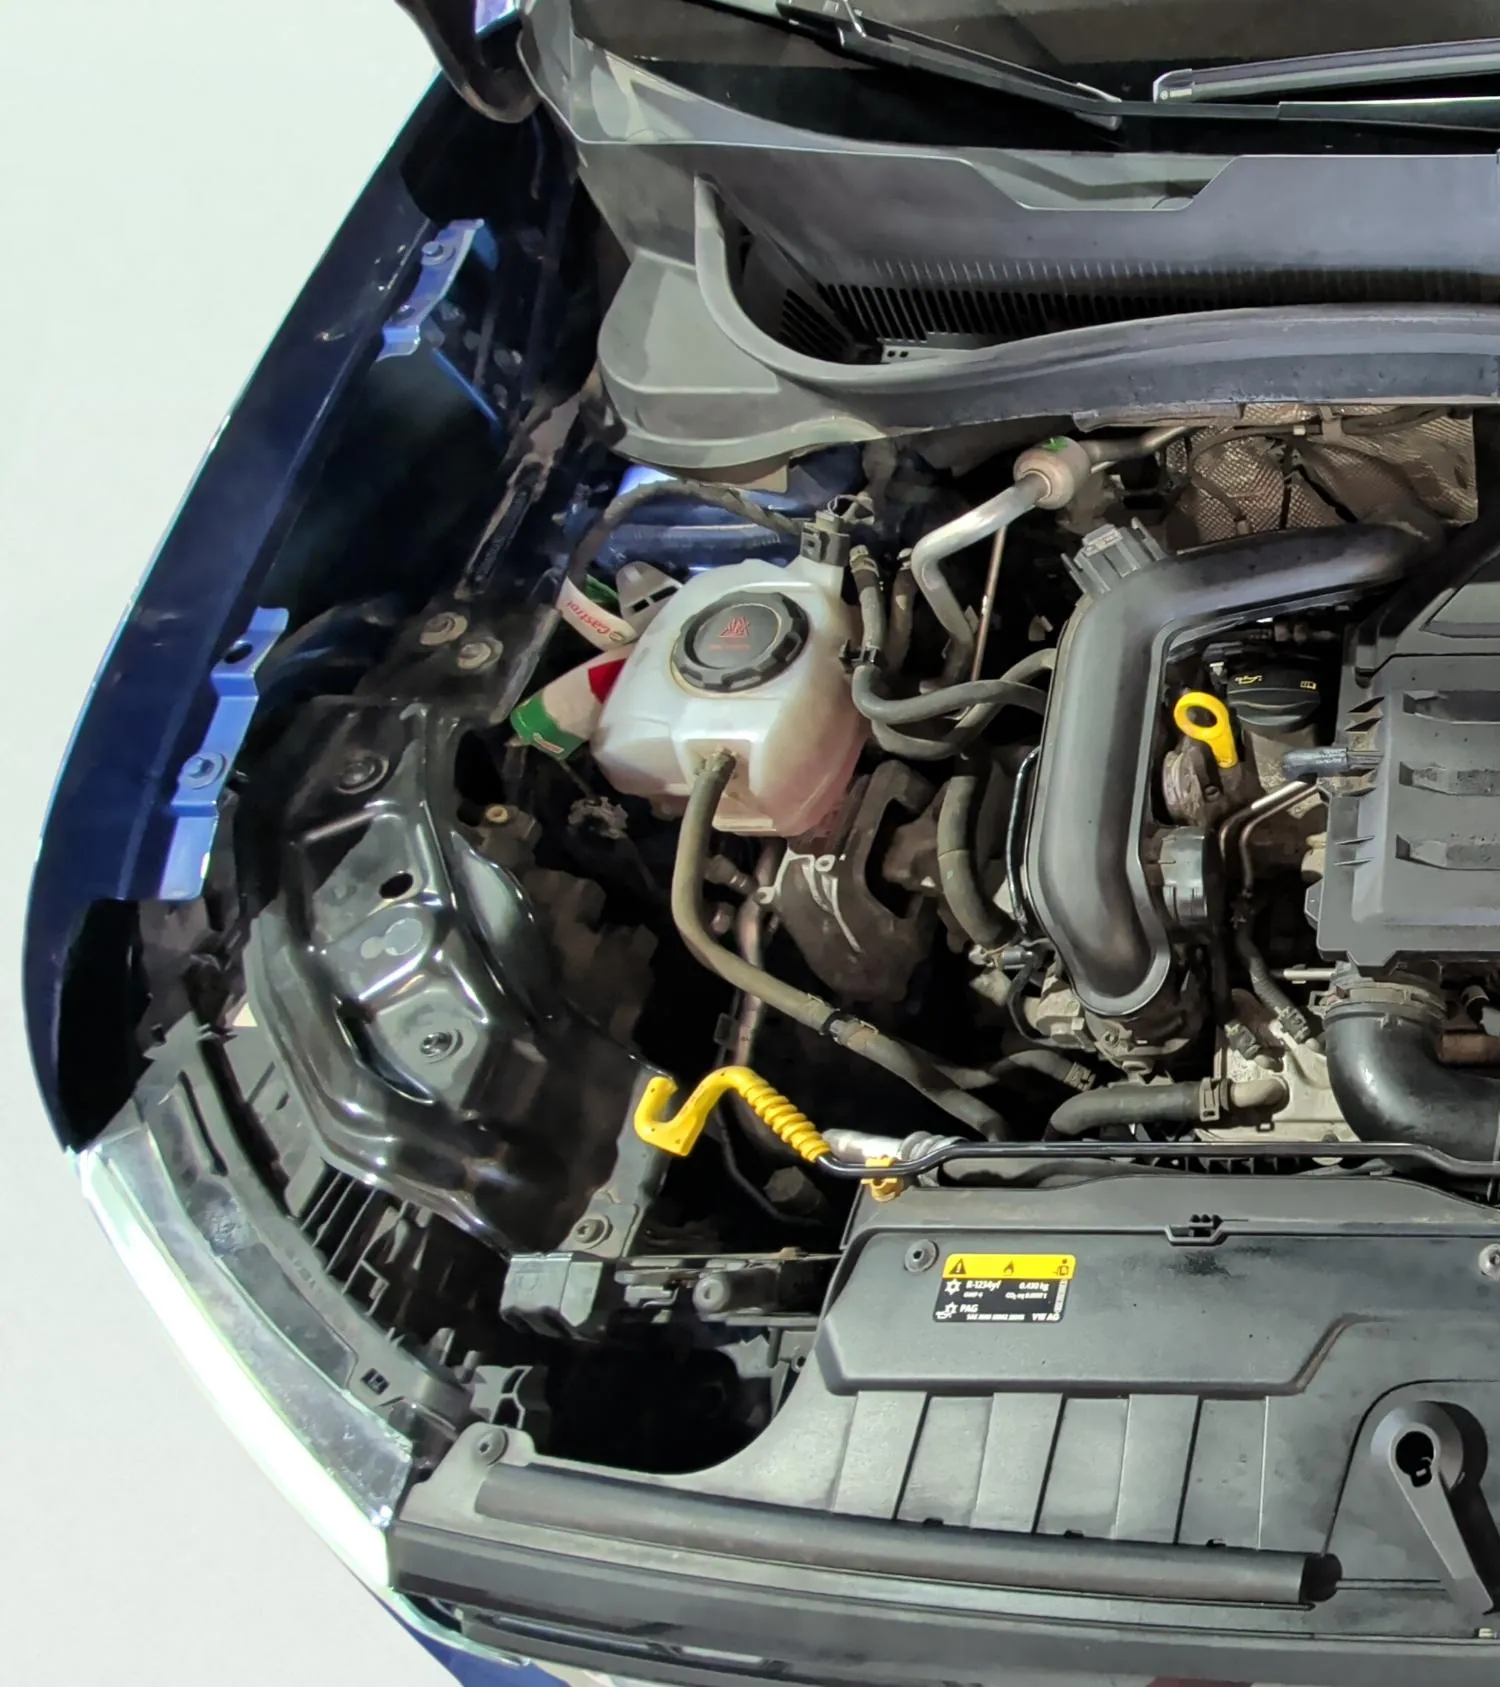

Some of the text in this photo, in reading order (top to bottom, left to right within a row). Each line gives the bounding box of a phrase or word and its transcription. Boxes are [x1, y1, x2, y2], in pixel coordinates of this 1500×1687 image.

[567, 601, 612, 635] Castrol
[959, 1303, 979, 1313] PAG
[1032, 1313, 1046, 1321] VW
[1047, 1313, 1061, 1321] AG
